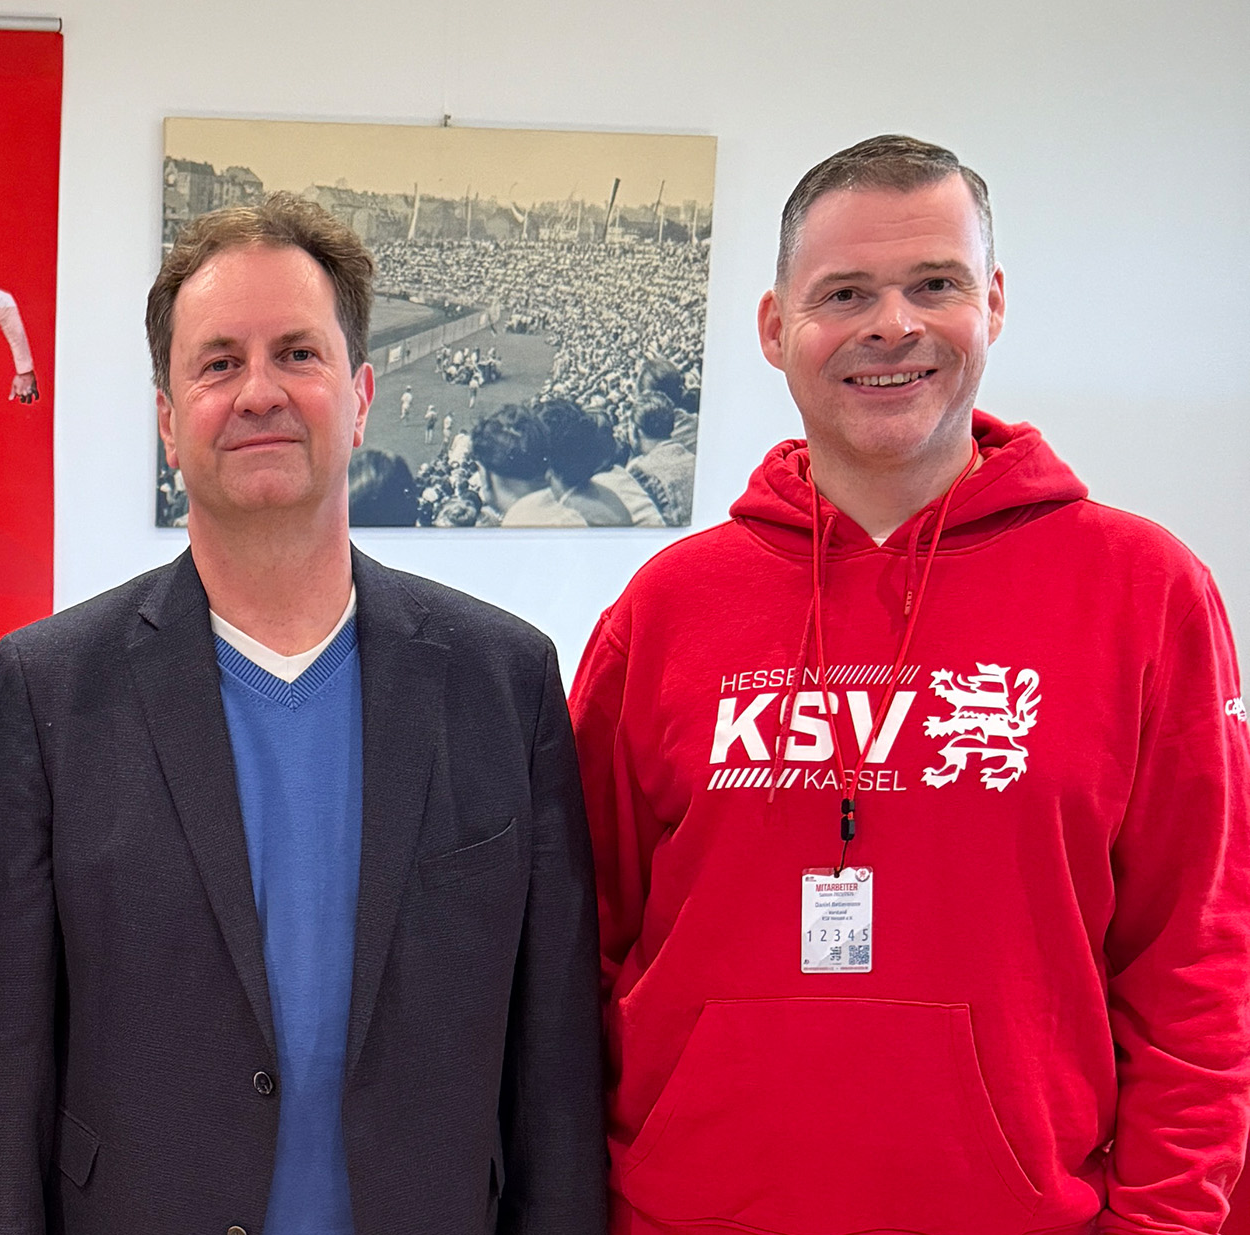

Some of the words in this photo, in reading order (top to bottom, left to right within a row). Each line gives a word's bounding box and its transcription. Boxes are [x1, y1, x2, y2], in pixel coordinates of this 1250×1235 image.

[720, 667, 820, 693] HESSEN
[709, 691, 917, 764] KSV
[815, 882, 858, 892] MITARBEITER
[807, 930, 812, 942] 1
[820, 929, 827, 942] 2
[834, 929, 841, 942] 3
[848, 929, 855, 941] 4
[862, 928, 869, 941] 5
